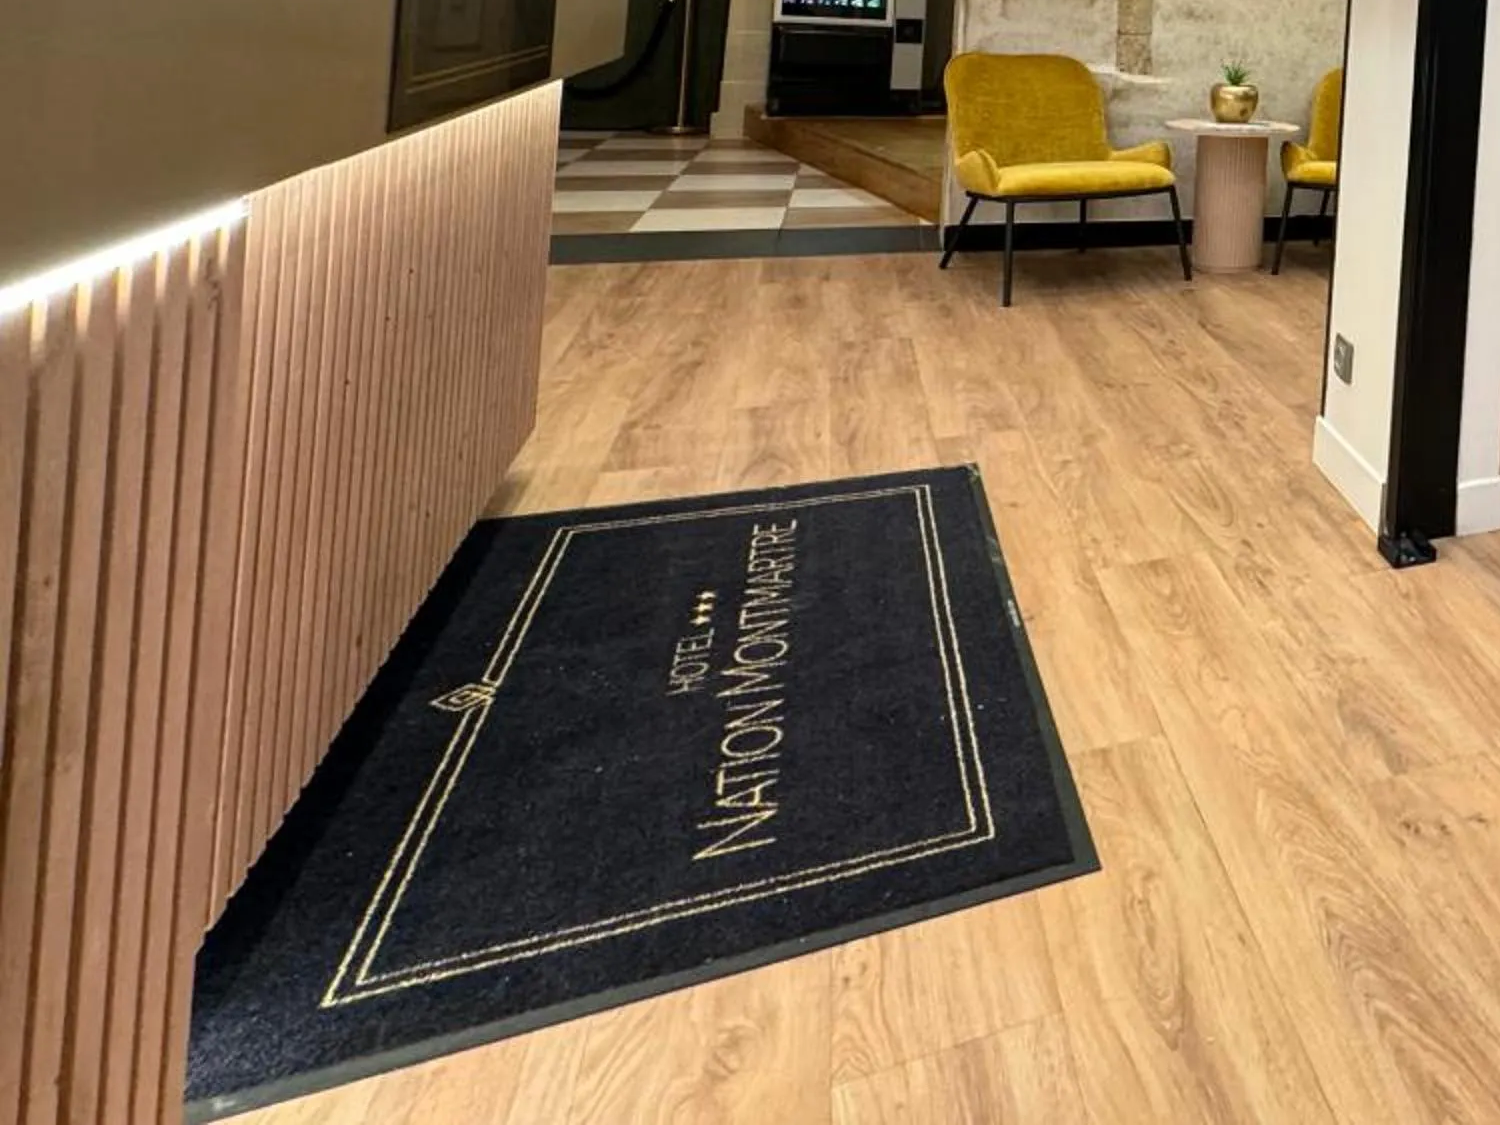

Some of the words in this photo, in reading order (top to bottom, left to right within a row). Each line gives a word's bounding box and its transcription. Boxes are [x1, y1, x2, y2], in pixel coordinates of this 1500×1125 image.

[666, 627, 715, 697] HOTEL
[716, 518, 798, 697] MONTMARTRE
[692, 698, 785, 860] NATION
